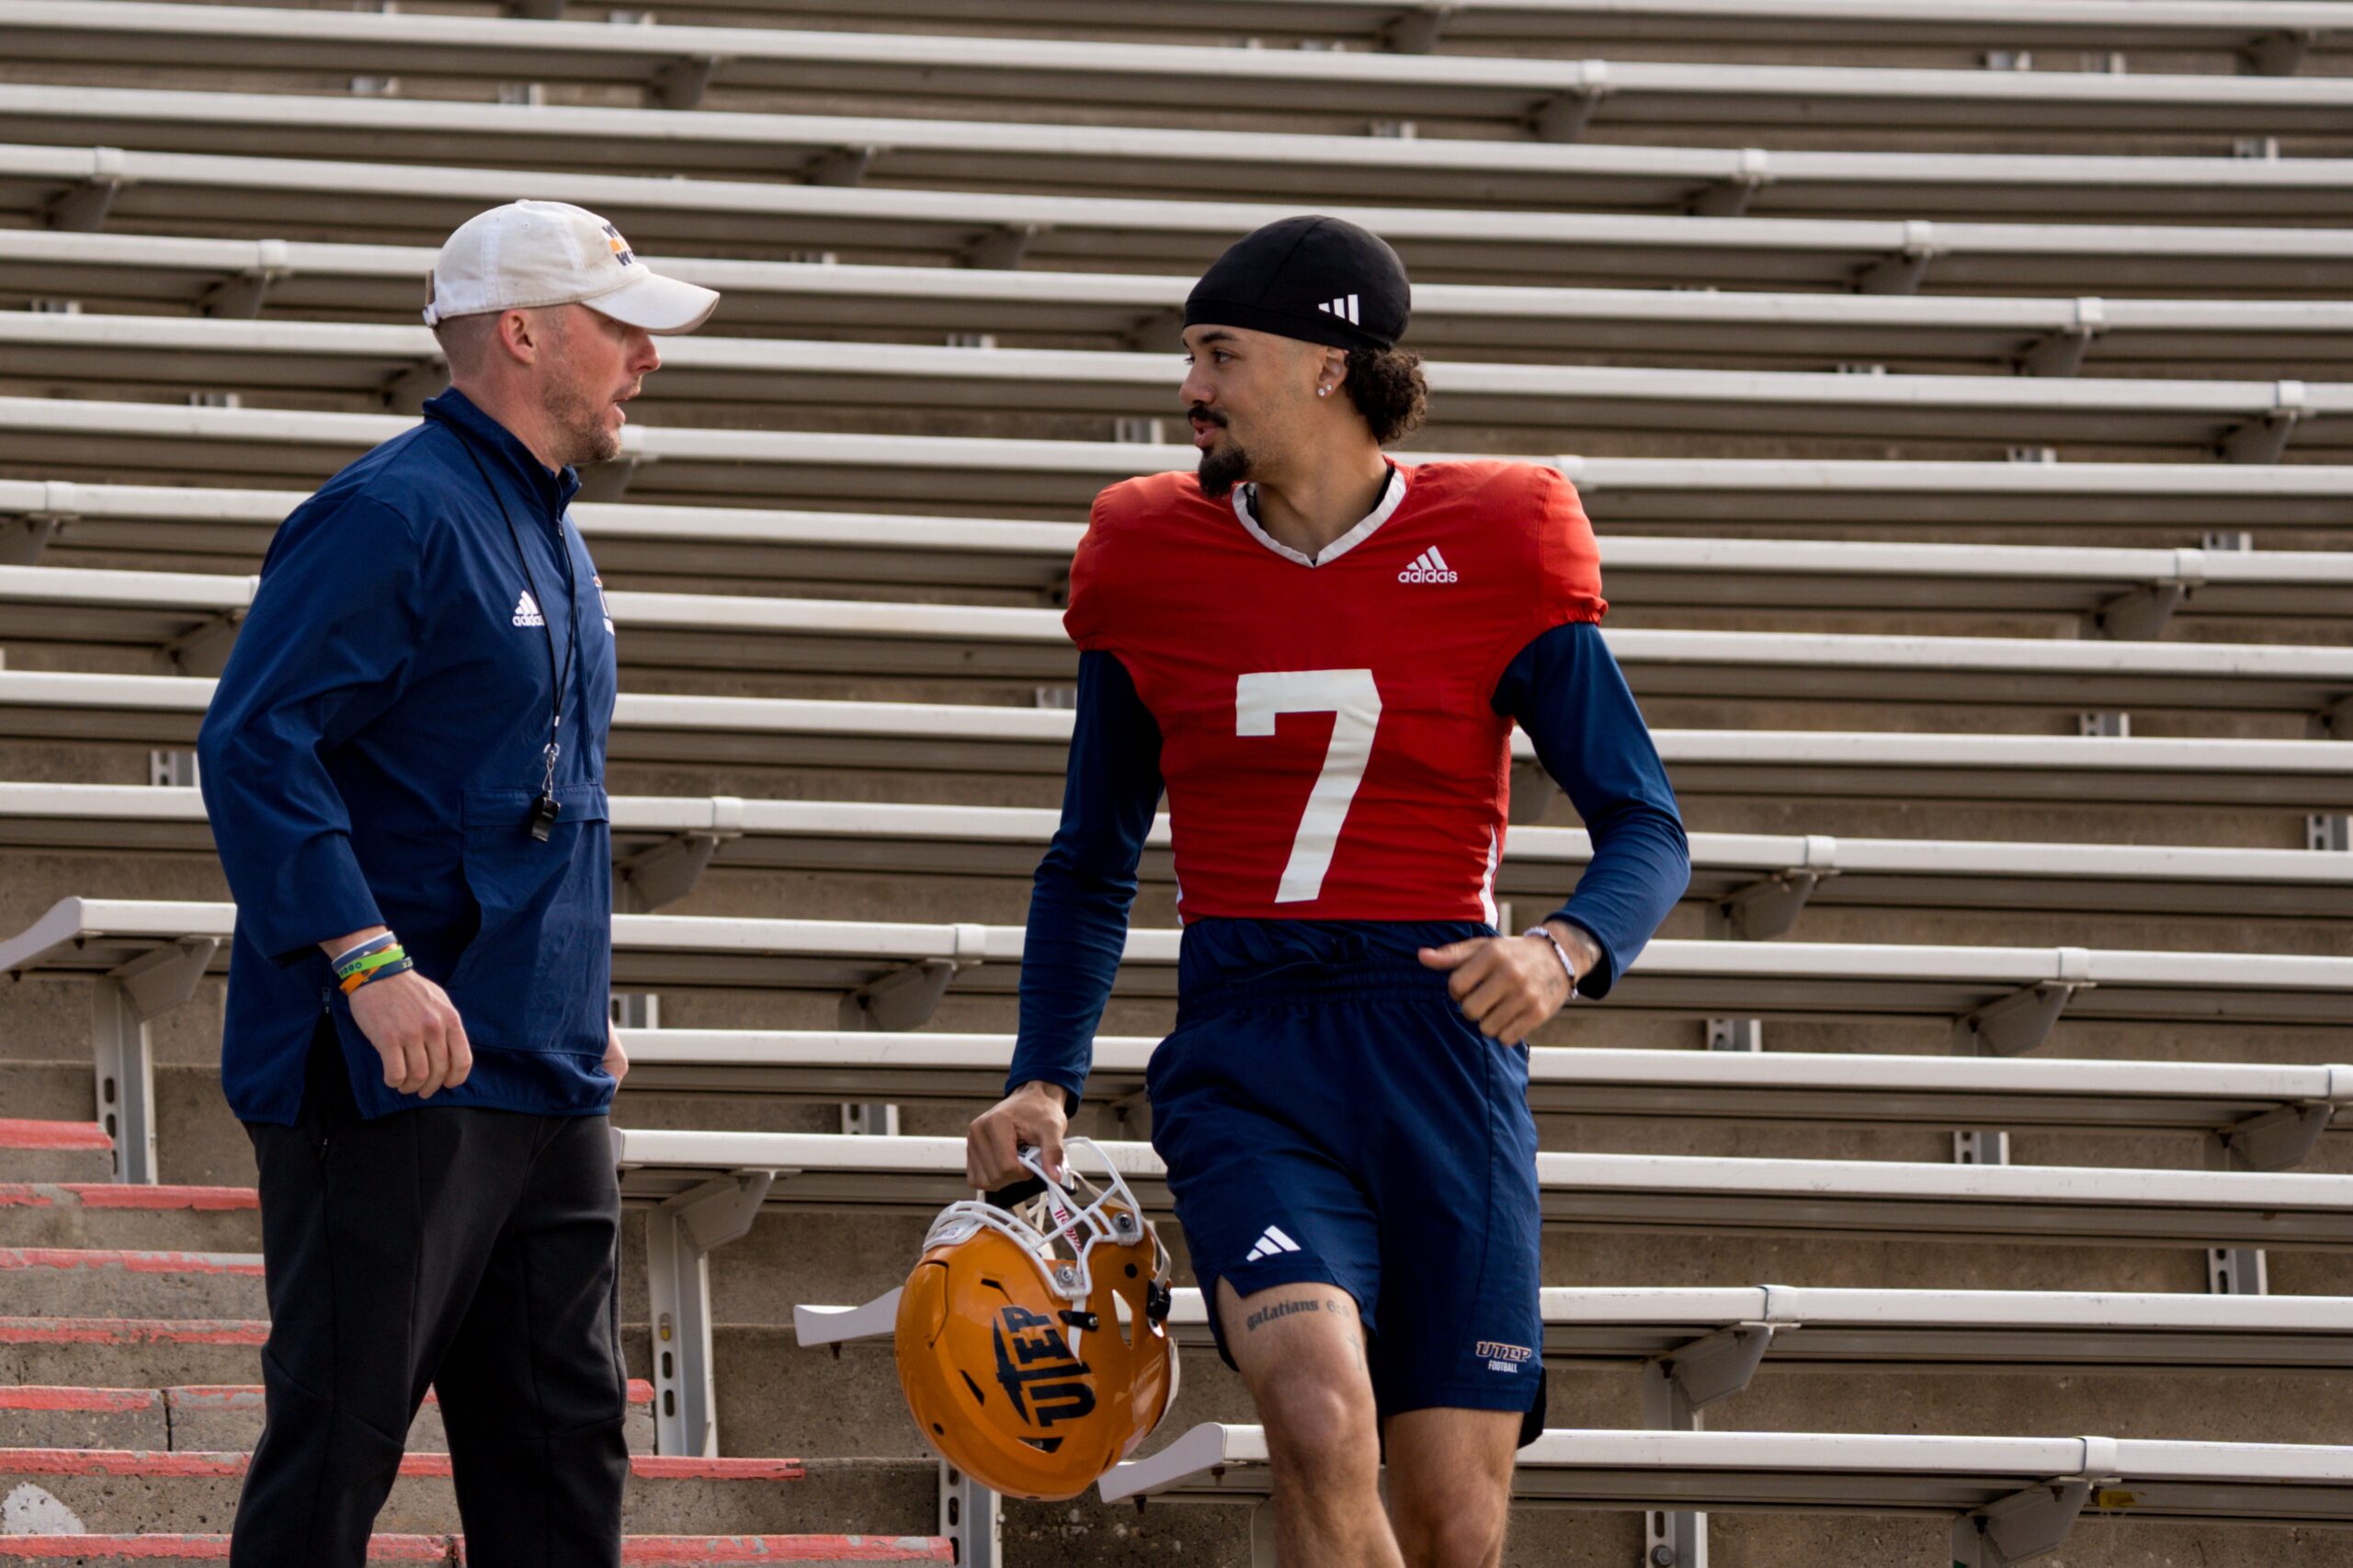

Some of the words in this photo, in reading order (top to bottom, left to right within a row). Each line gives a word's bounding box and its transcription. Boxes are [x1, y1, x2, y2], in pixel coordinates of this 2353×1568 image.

[1397, 569, 1458, 584] adidas
[1235, 669, 1382, 903] 7
[1475, 1341, 1532, 1362] UTEP
[993, 1305, 1097, 1427] UTEP
[1488, 1360, 1518, 1373] FOOTBALL
